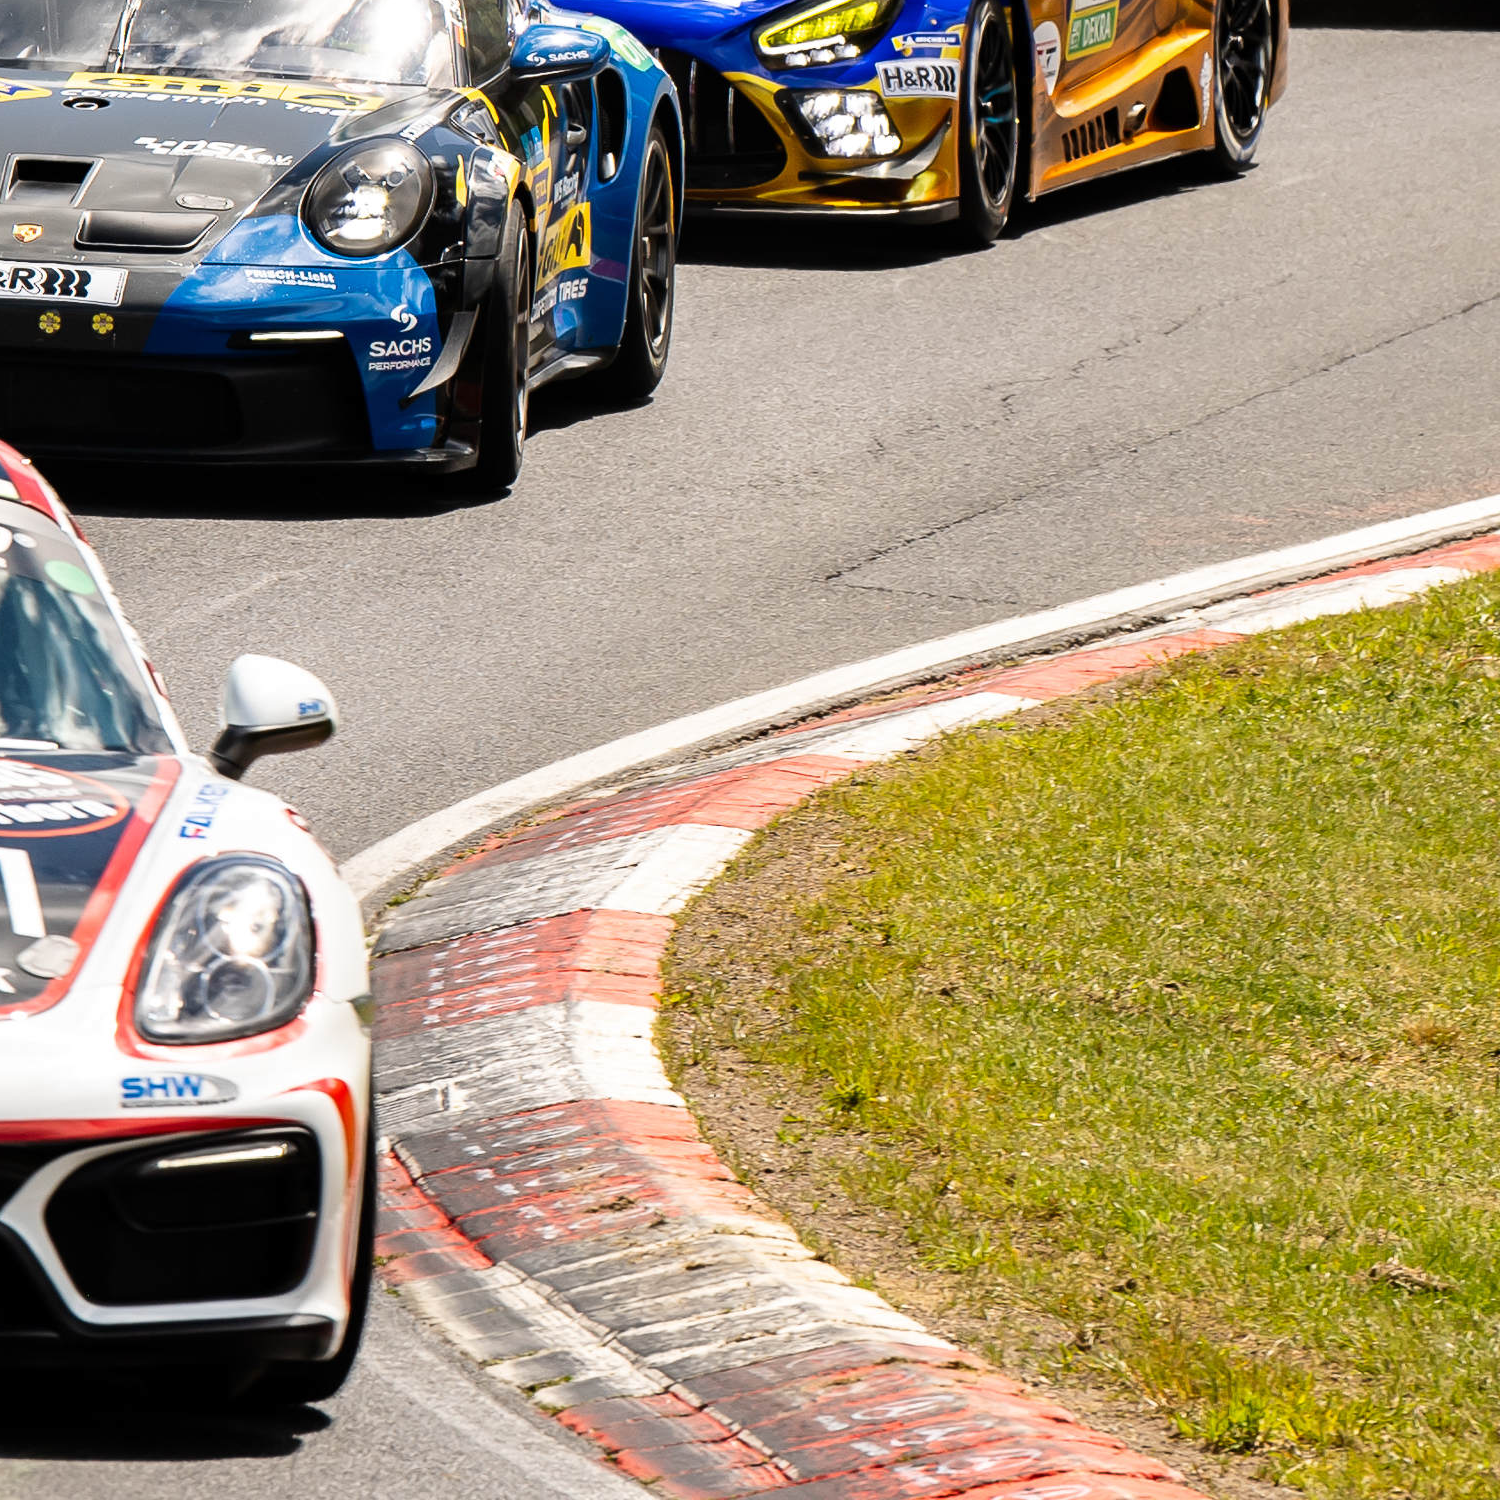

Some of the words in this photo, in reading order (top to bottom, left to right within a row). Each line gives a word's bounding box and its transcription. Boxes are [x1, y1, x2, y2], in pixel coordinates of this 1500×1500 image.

[1081, 10, 1112, 48] DEKRA
[547, 49, 590, 61] SACHS
[884, 66, 930, 89] H&R
[369, 337, 432, 358] SACHS
[368, 357, 431, 371] PERFORMANCE
[121, 1074, 201, 1100] SHW
